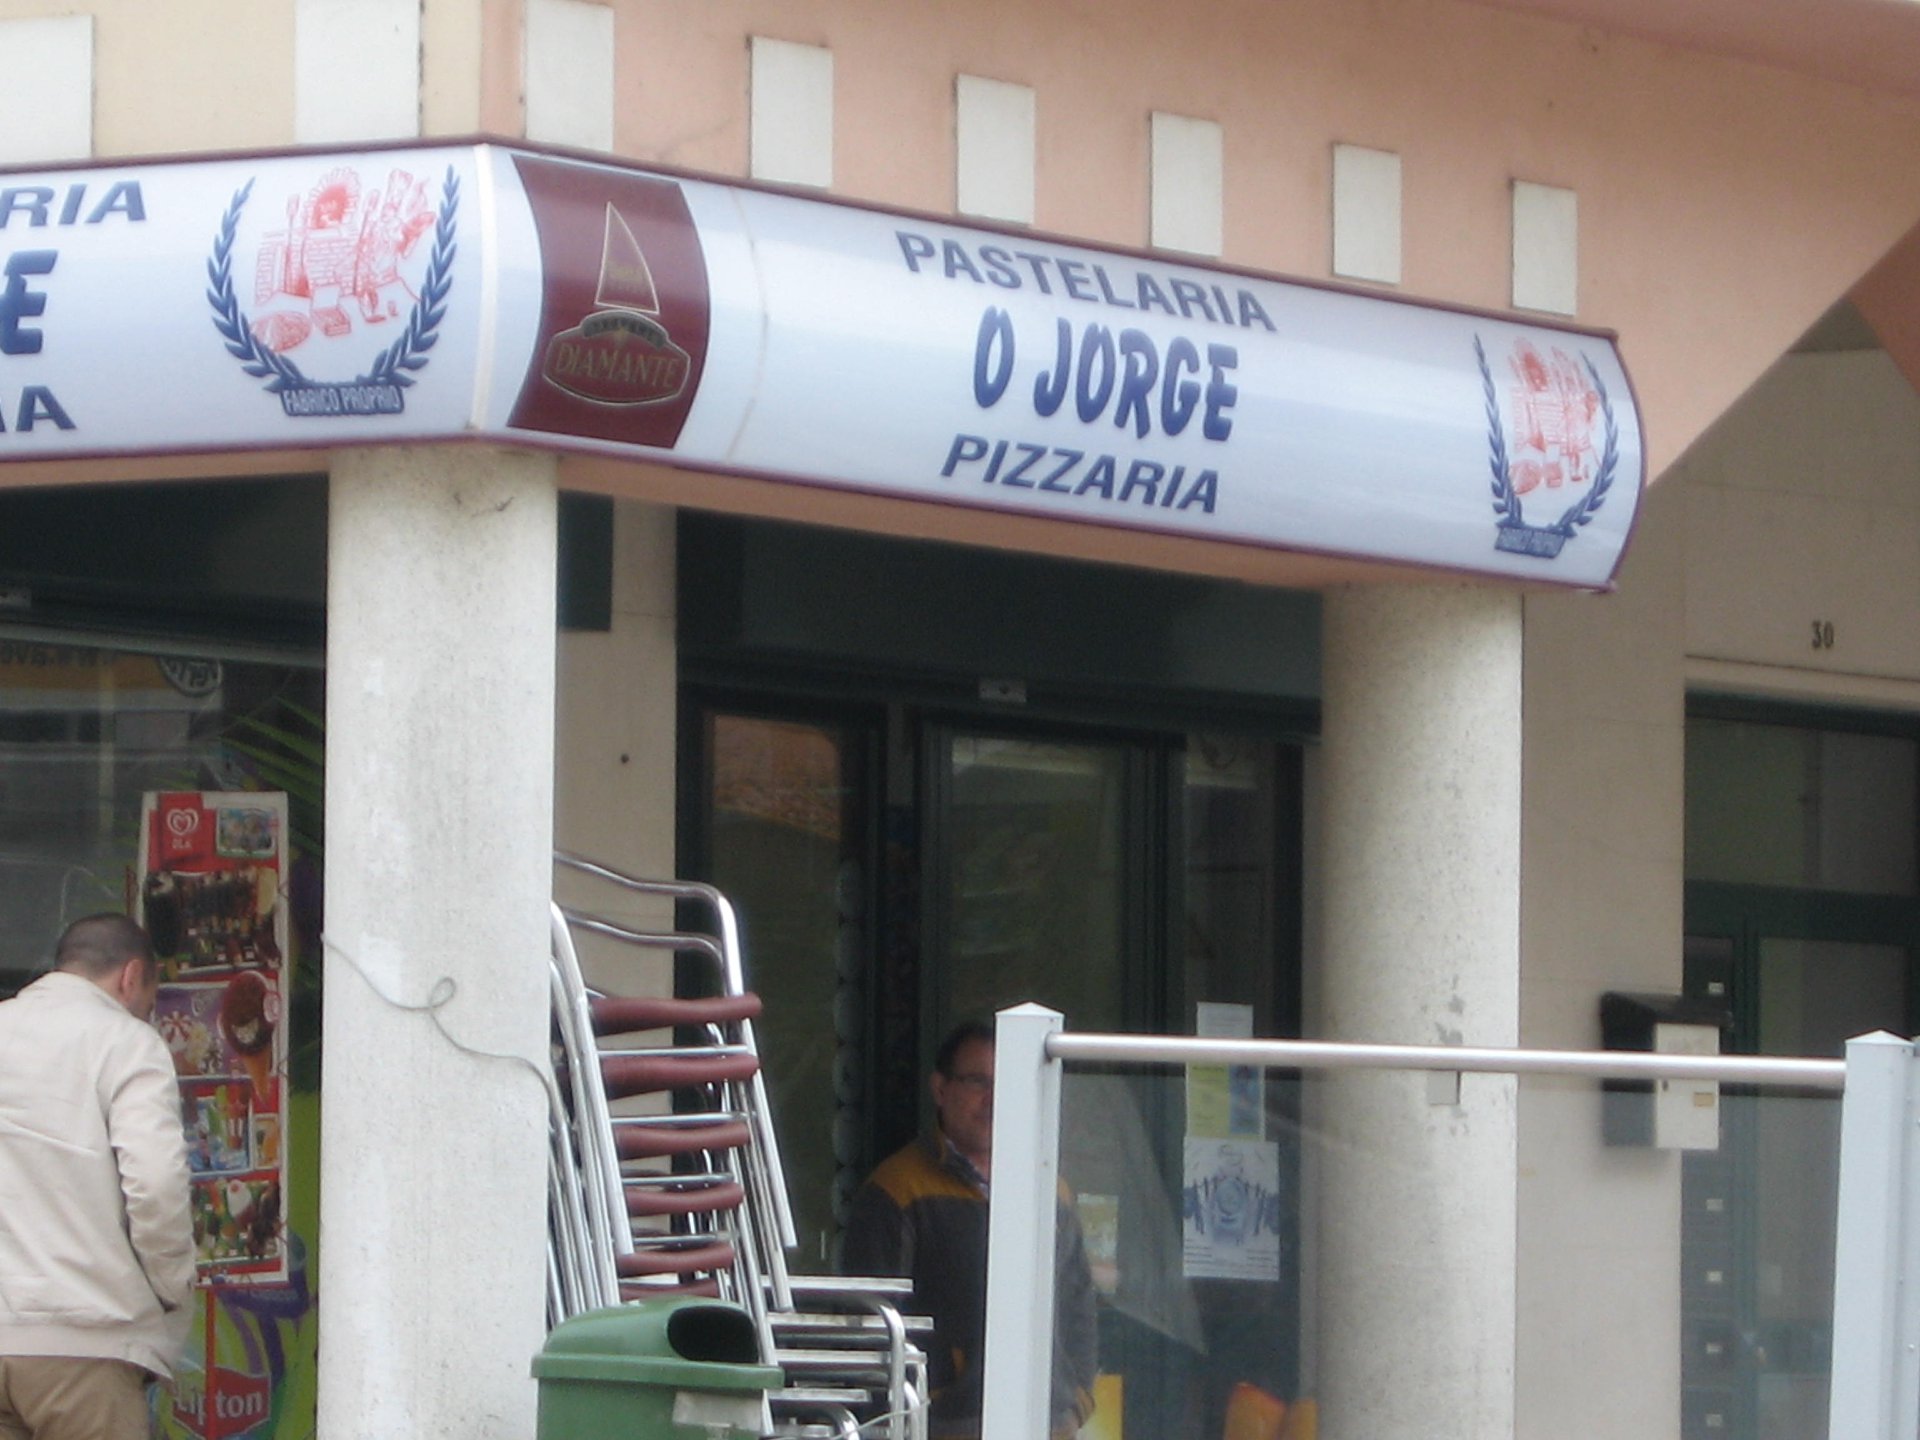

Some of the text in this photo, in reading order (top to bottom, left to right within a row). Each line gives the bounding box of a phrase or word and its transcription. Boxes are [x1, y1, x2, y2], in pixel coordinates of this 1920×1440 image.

[0, 180, 147, 228] RIA
[896, 231, 1277, 332] PASTELARIA
[554, 343, 681, 388] DIAMANTE
[974, 305, 1238, 441] O JORGE
[0, 385, 77, 432] A
[941, 433, 1219, 513] PIZZARIA
[1812, 620, 1834, 649] 30
